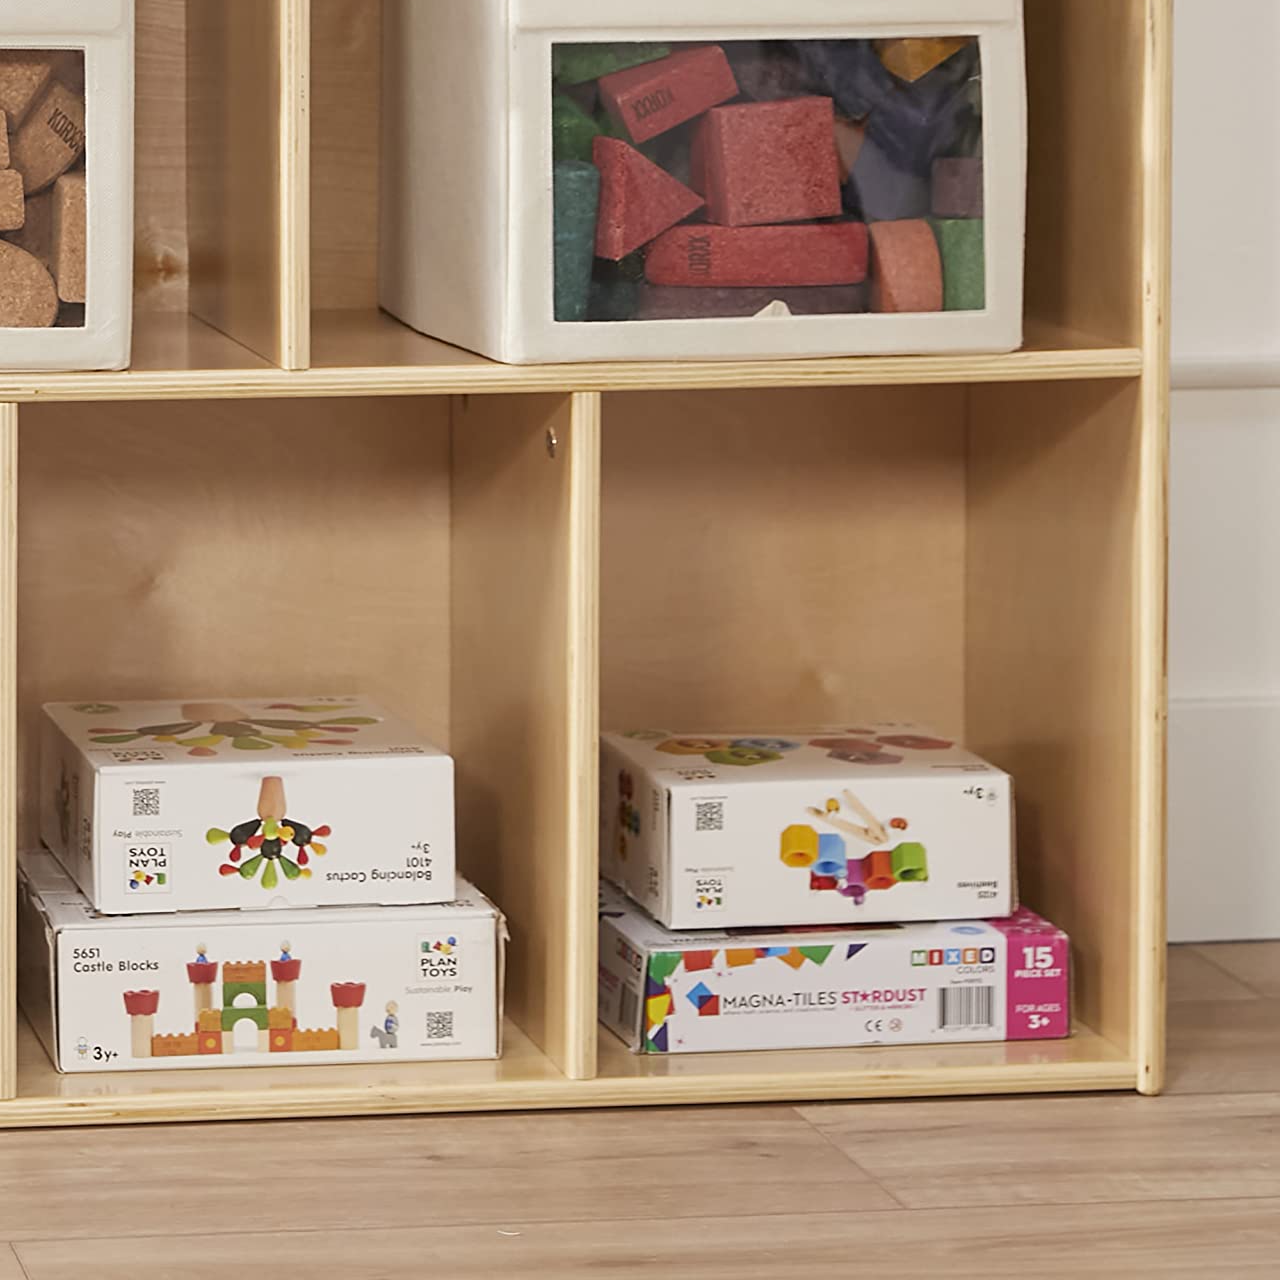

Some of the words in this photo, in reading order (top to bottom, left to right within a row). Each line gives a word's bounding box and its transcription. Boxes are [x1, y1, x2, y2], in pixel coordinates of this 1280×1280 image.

[129, 847, 166, 857] TOYS
[129, 858, 167, 868] PLAN
[406, 856, 433, 868] 4101
[326, 871, 367, 883] Cactus
[371, 869, 432, 882] Balancing
[73, 948, 100, 959] 5651
[911, 947, 995, 966] MIXED
[1022, 946, 1054, 969] 15
[73, 962, 113, 972] Castle
[119, 960, 159, 971] Blocks
[421, 958, 457, 966] PLAN
[421, 968, 457, 977] TOYS
[723, 991, 837, 1008] MAGNA-TILES
[1028, 1014, 1051, 1029] 3+
[93, 1046, 118, 1062] 3y+
